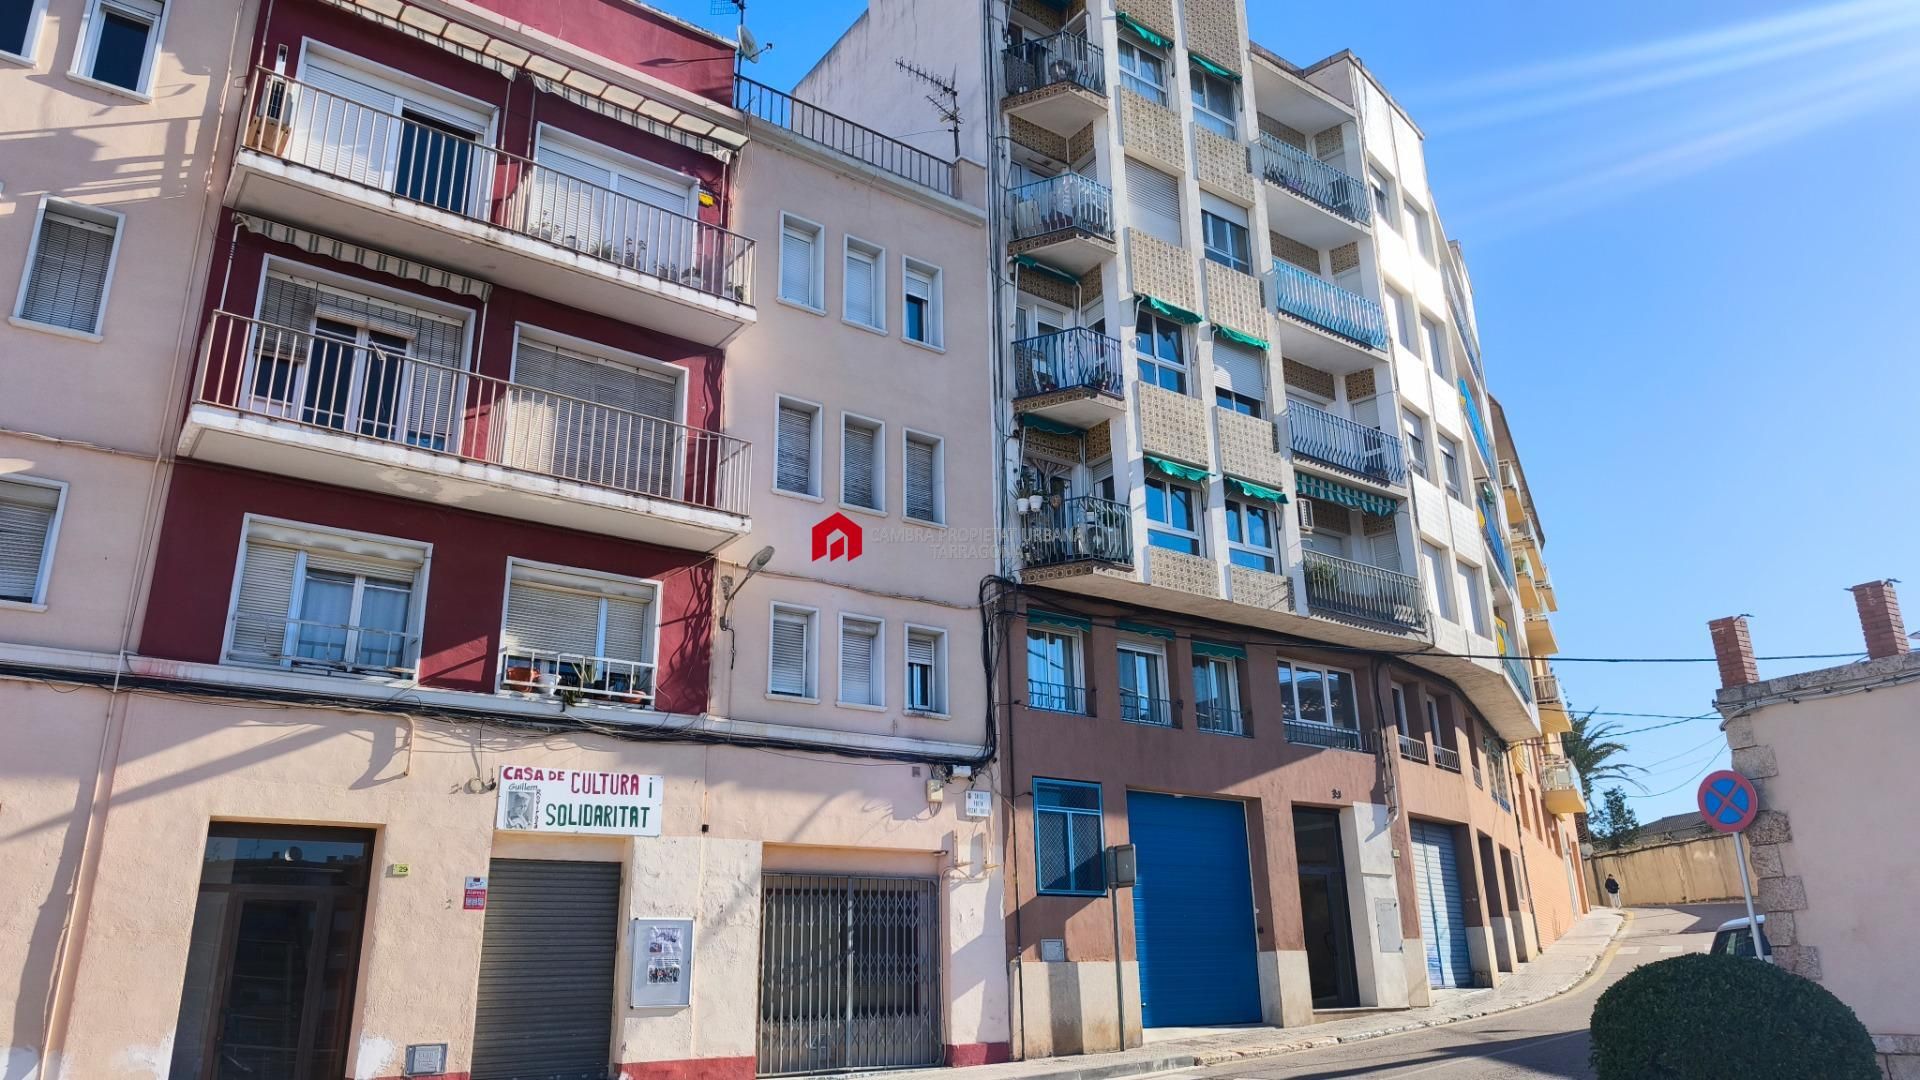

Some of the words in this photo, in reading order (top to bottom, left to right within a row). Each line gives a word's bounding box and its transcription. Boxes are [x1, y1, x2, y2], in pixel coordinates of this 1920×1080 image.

[503, 766, 544, 781] CASA
[548, 770, 565, 782] DE
[571, 772, 639, 796] CULTURA
[508, 782, 537, 792] Guillem
[546, 803, 650, 828] SOLIDARITAT
